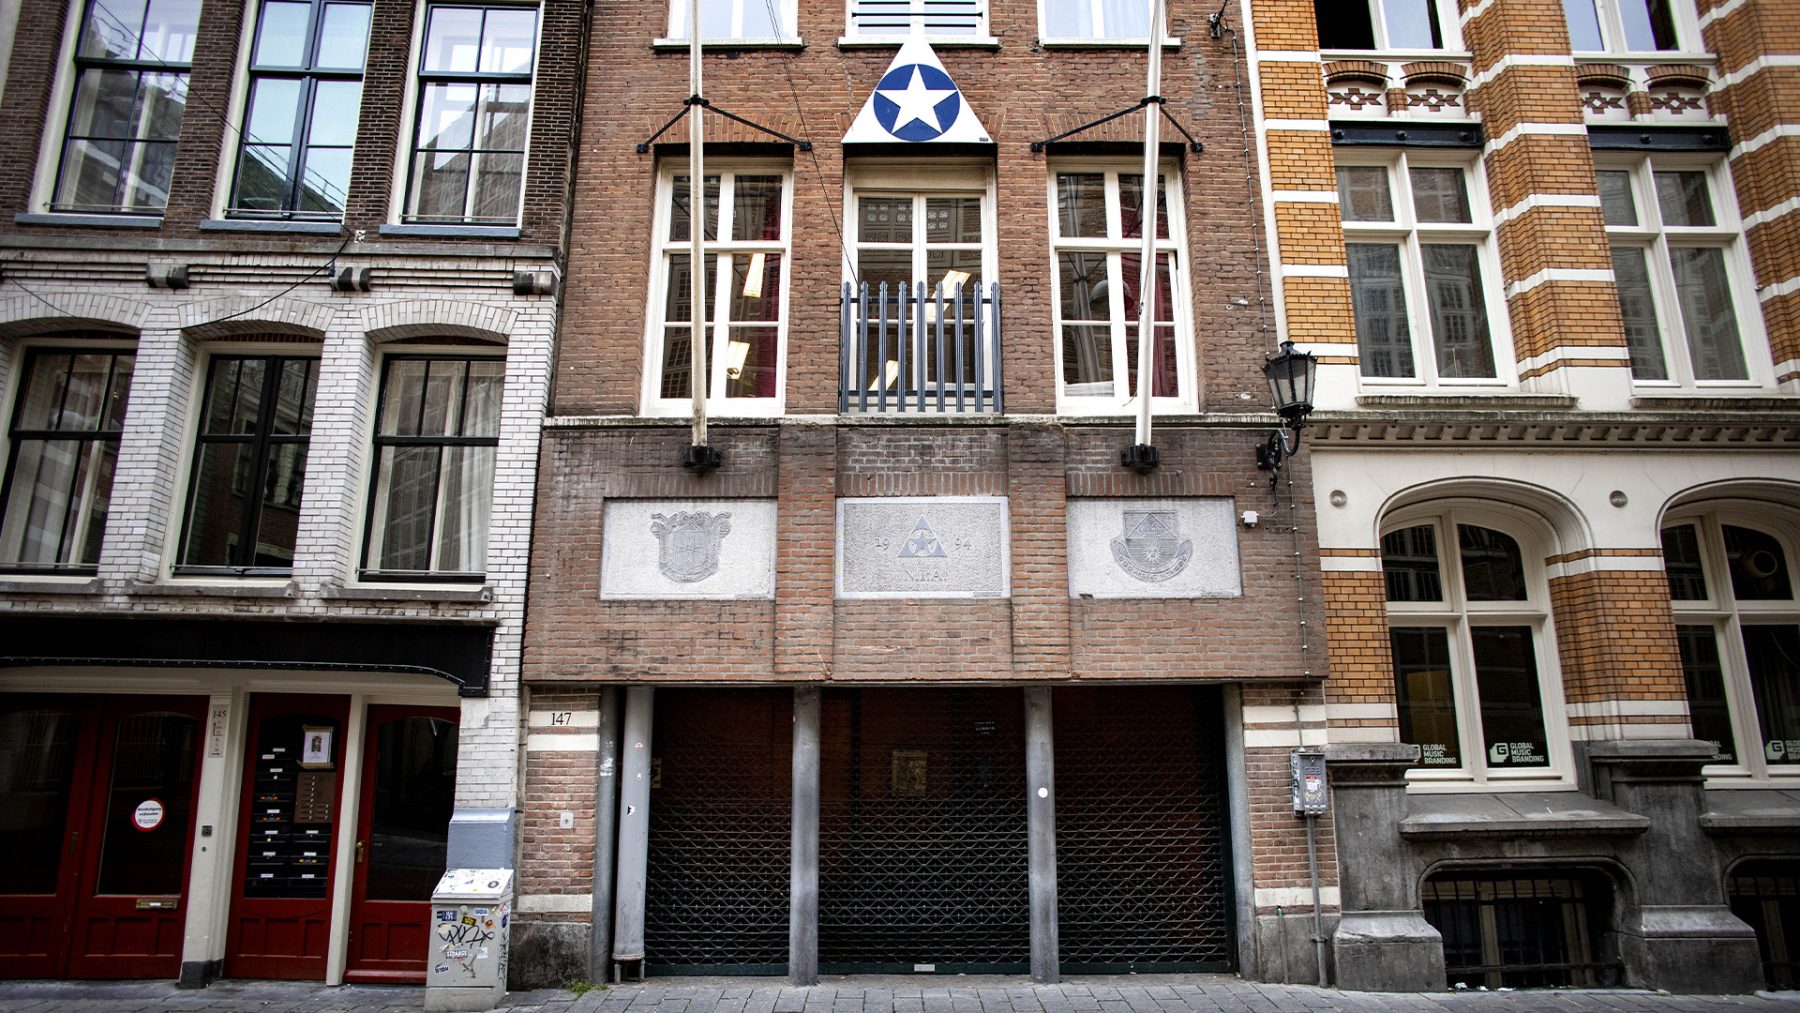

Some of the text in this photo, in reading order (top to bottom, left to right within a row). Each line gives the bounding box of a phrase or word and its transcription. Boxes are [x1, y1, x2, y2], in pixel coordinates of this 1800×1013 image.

[551, 712, 572, 726] 147
[1510, 742, 1535, 750] GLOBAL
[1423, 750, 1444, 758] MUSIC
[1424, 757, 1457, 765] BRANDING
[1512, 755, 1545, 763] BRANDING
